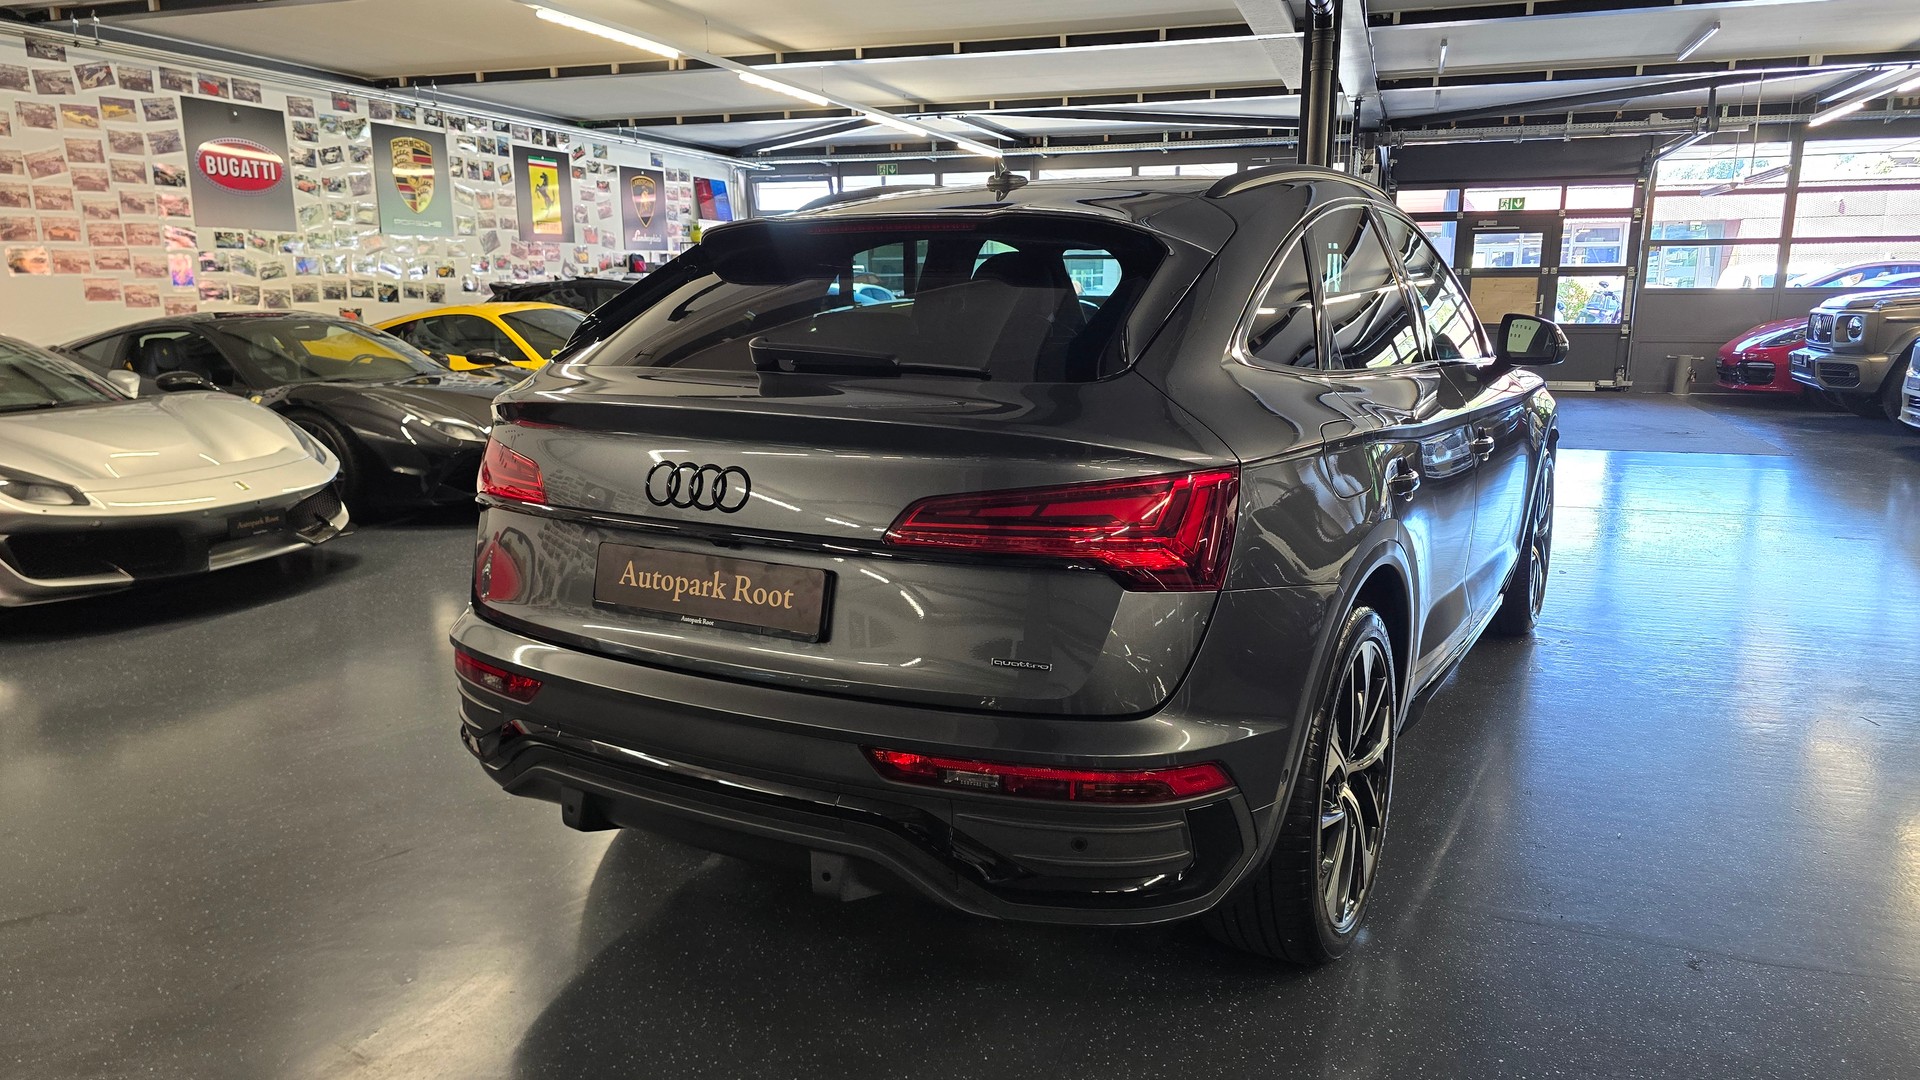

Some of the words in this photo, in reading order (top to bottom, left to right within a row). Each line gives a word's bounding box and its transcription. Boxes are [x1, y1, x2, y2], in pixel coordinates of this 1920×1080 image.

[392, 139, 431, 153] PORSCHE
[204, 155, 277, 181] BUGATTI
[619, 560, 727, 602] Autopark
[732, 575, 795, 610] Root
[680, 615, 702, 625] Autopark
[702, 618, 715, 626] Root
[994, 659, 1049, 670] quattro
